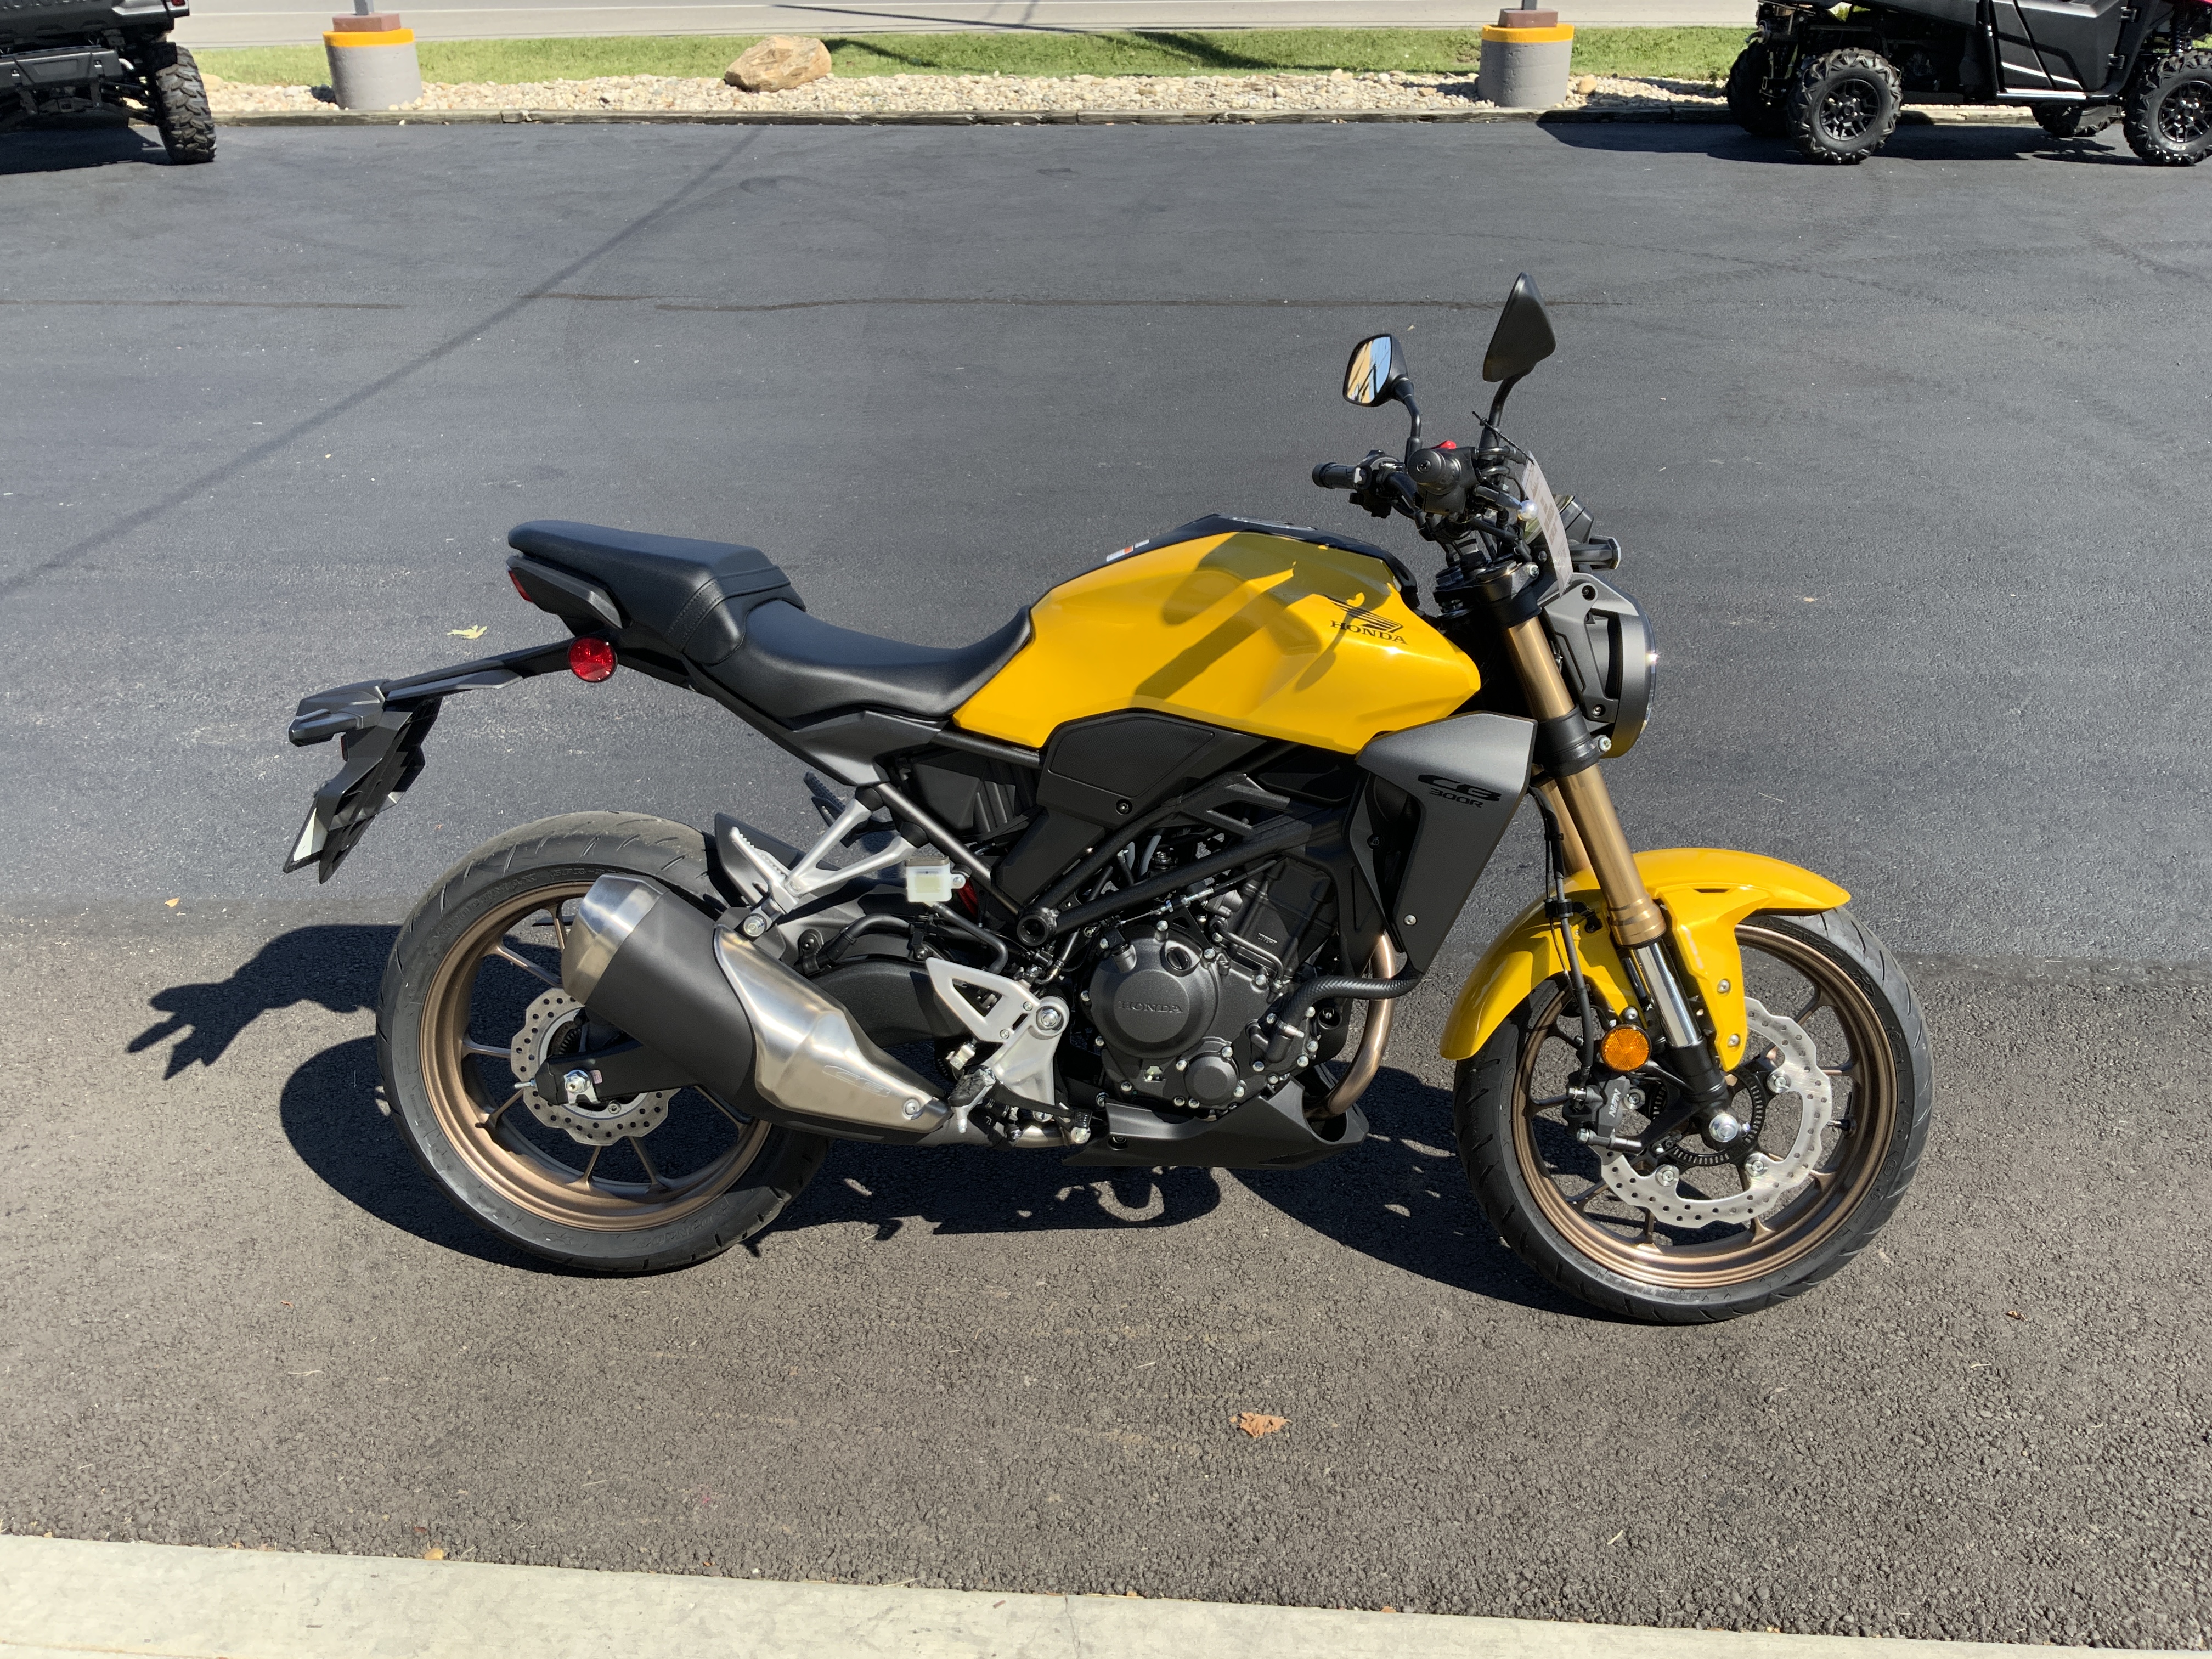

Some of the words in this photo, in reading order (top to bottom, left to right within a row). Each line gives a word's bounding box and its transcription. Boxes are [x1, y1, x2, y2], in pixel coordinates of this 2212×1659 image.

[1329, 620, 1408, 645] HONDA
[1418, 774, 1502, 802] CB
[1429, 788, 1484, 808] 300R
[1118, 1001, 1183, 1014] HONDA
